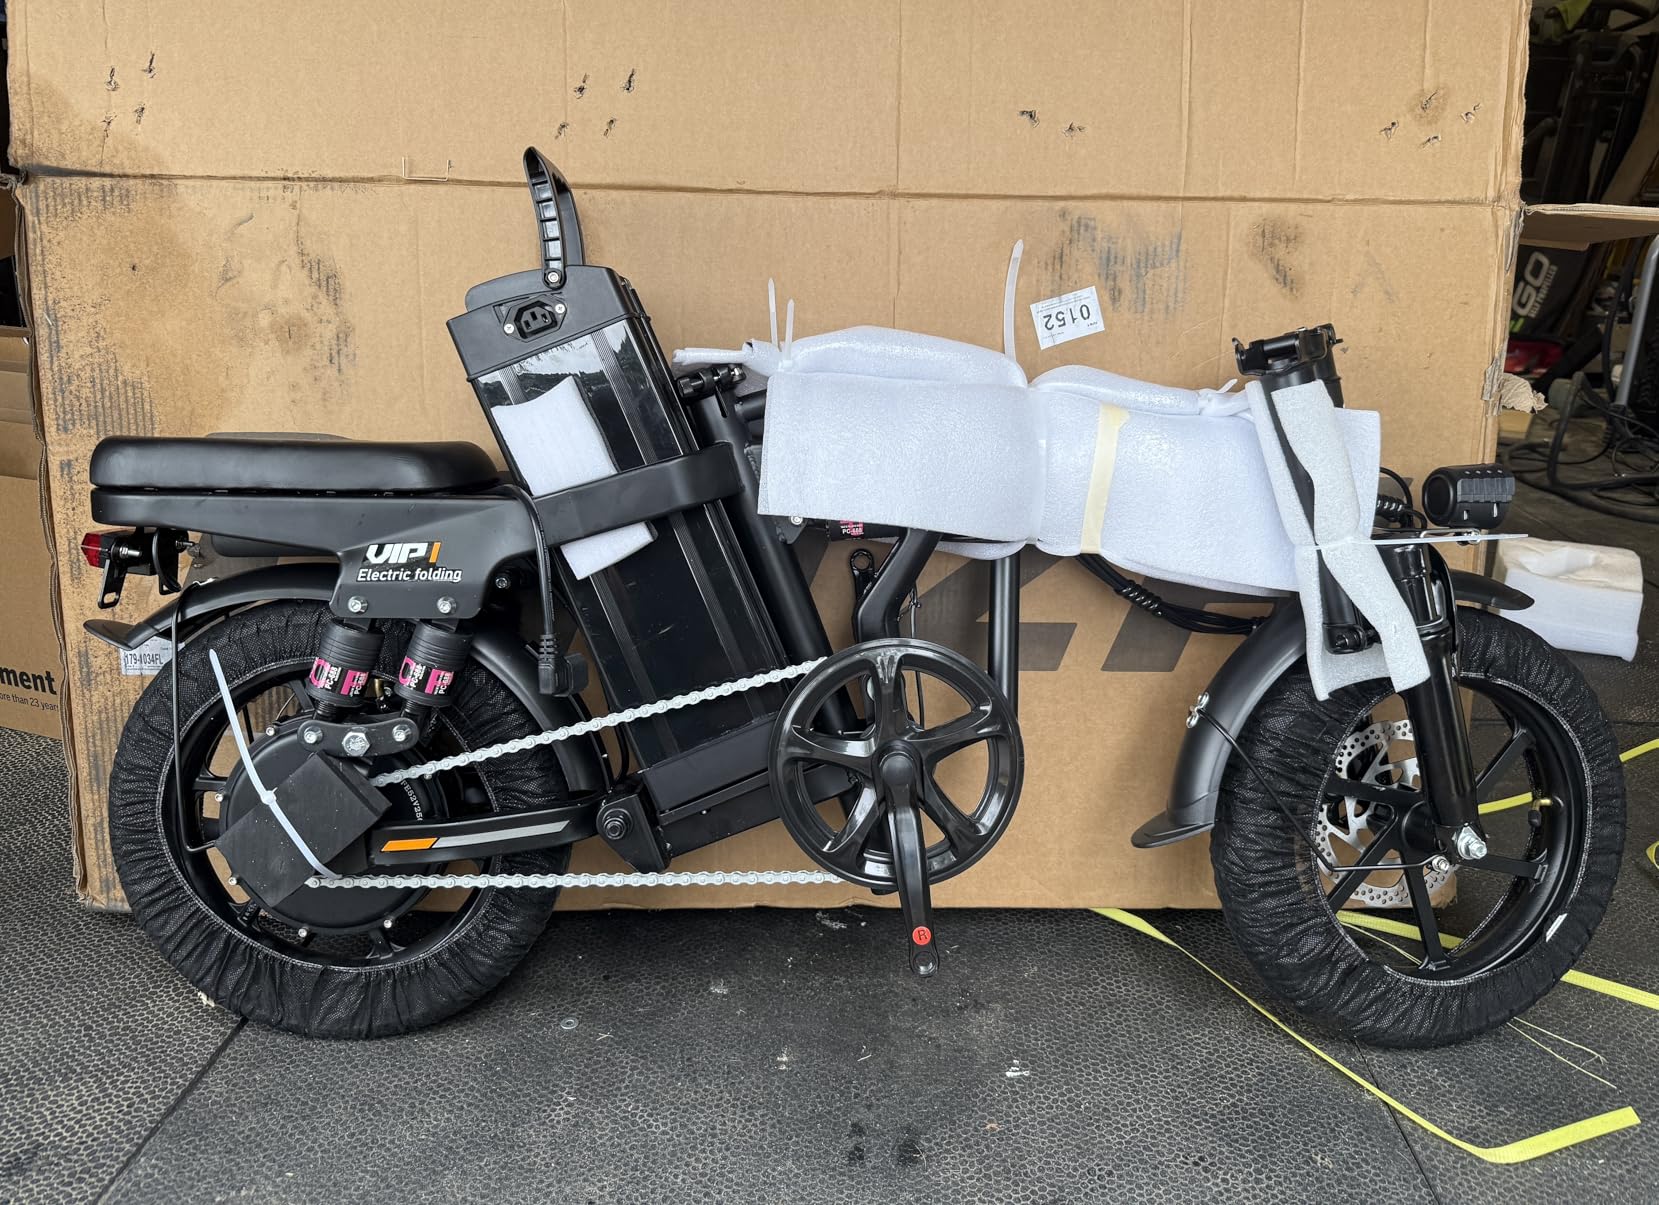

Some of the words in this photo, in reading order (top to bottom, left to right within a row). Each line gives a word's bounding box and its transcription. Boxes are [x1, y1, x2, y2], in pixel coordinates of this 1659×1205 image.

[1042, 304, 1091, 331] 0152
[357, 568, 412, 581] Electric
[414, 567, 462, 583] folding
[0, 666, 57, 695] ment
[12, 693, 29, 705] than
[30, 697, 39, 707] 23
[917, 929, 928, 941] R
